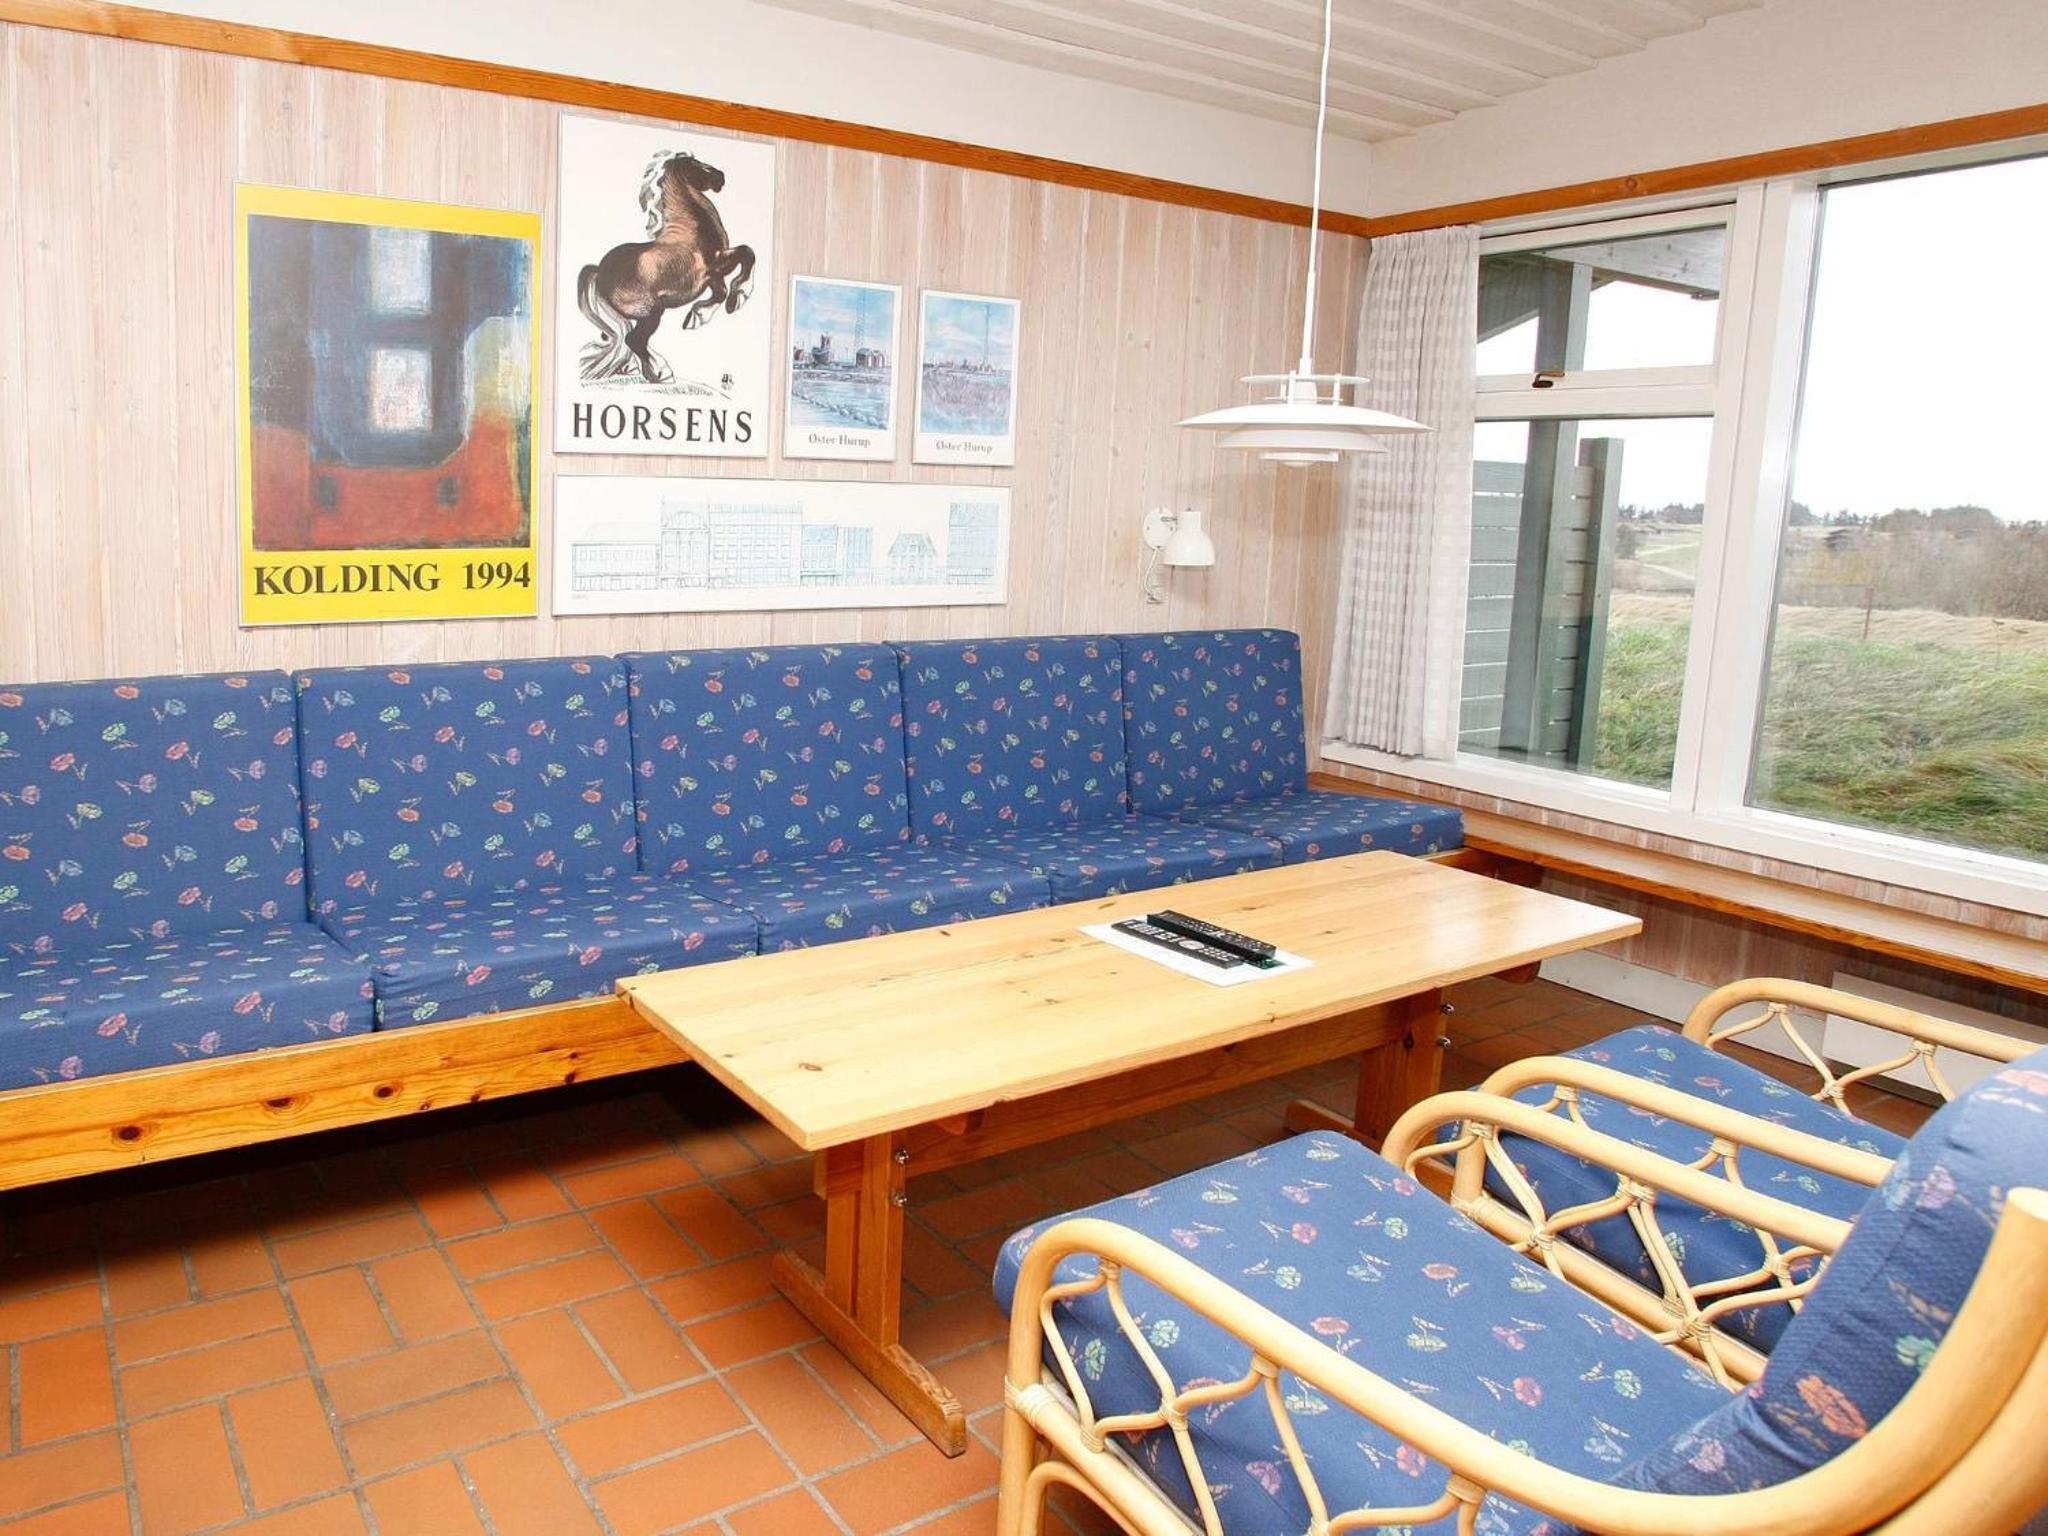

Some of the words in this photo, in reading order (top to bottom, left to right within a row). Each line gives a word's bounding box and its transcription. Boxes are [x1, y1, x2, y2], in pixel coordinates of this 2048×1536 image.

[573, 402, 753, 444] HORSENS
[252, 562, 441, 596] KOLDING
[461, 561, 531, 590] 1994
